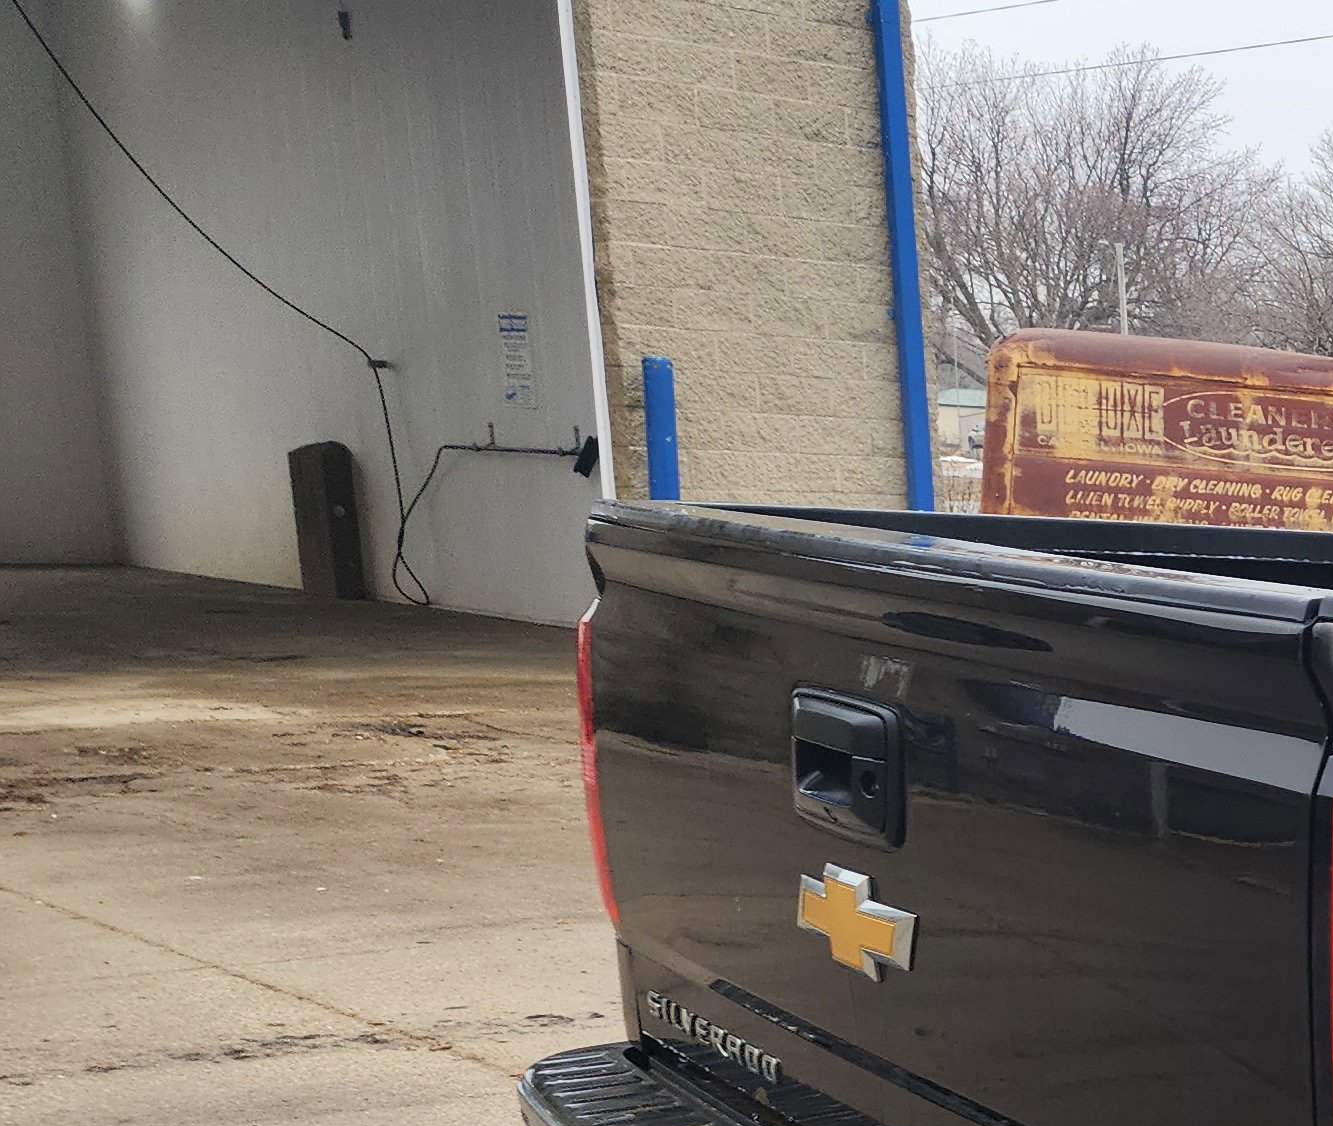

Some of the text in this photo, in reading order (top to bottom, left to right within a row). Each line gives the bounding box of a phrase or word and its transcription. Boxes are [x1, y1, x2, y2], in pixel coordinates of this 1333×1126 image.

[1120, 442, 1162, 455] IOWA
[1065, 469, 1144, 488] LAUNDRY
[1151, 475, 1188, 492] DRY
[1189, 478, 1263, 499] CLEANING
[1271, 485, 1303, 502] RUG
[647, 989, 784, 1085] SILVERADO
